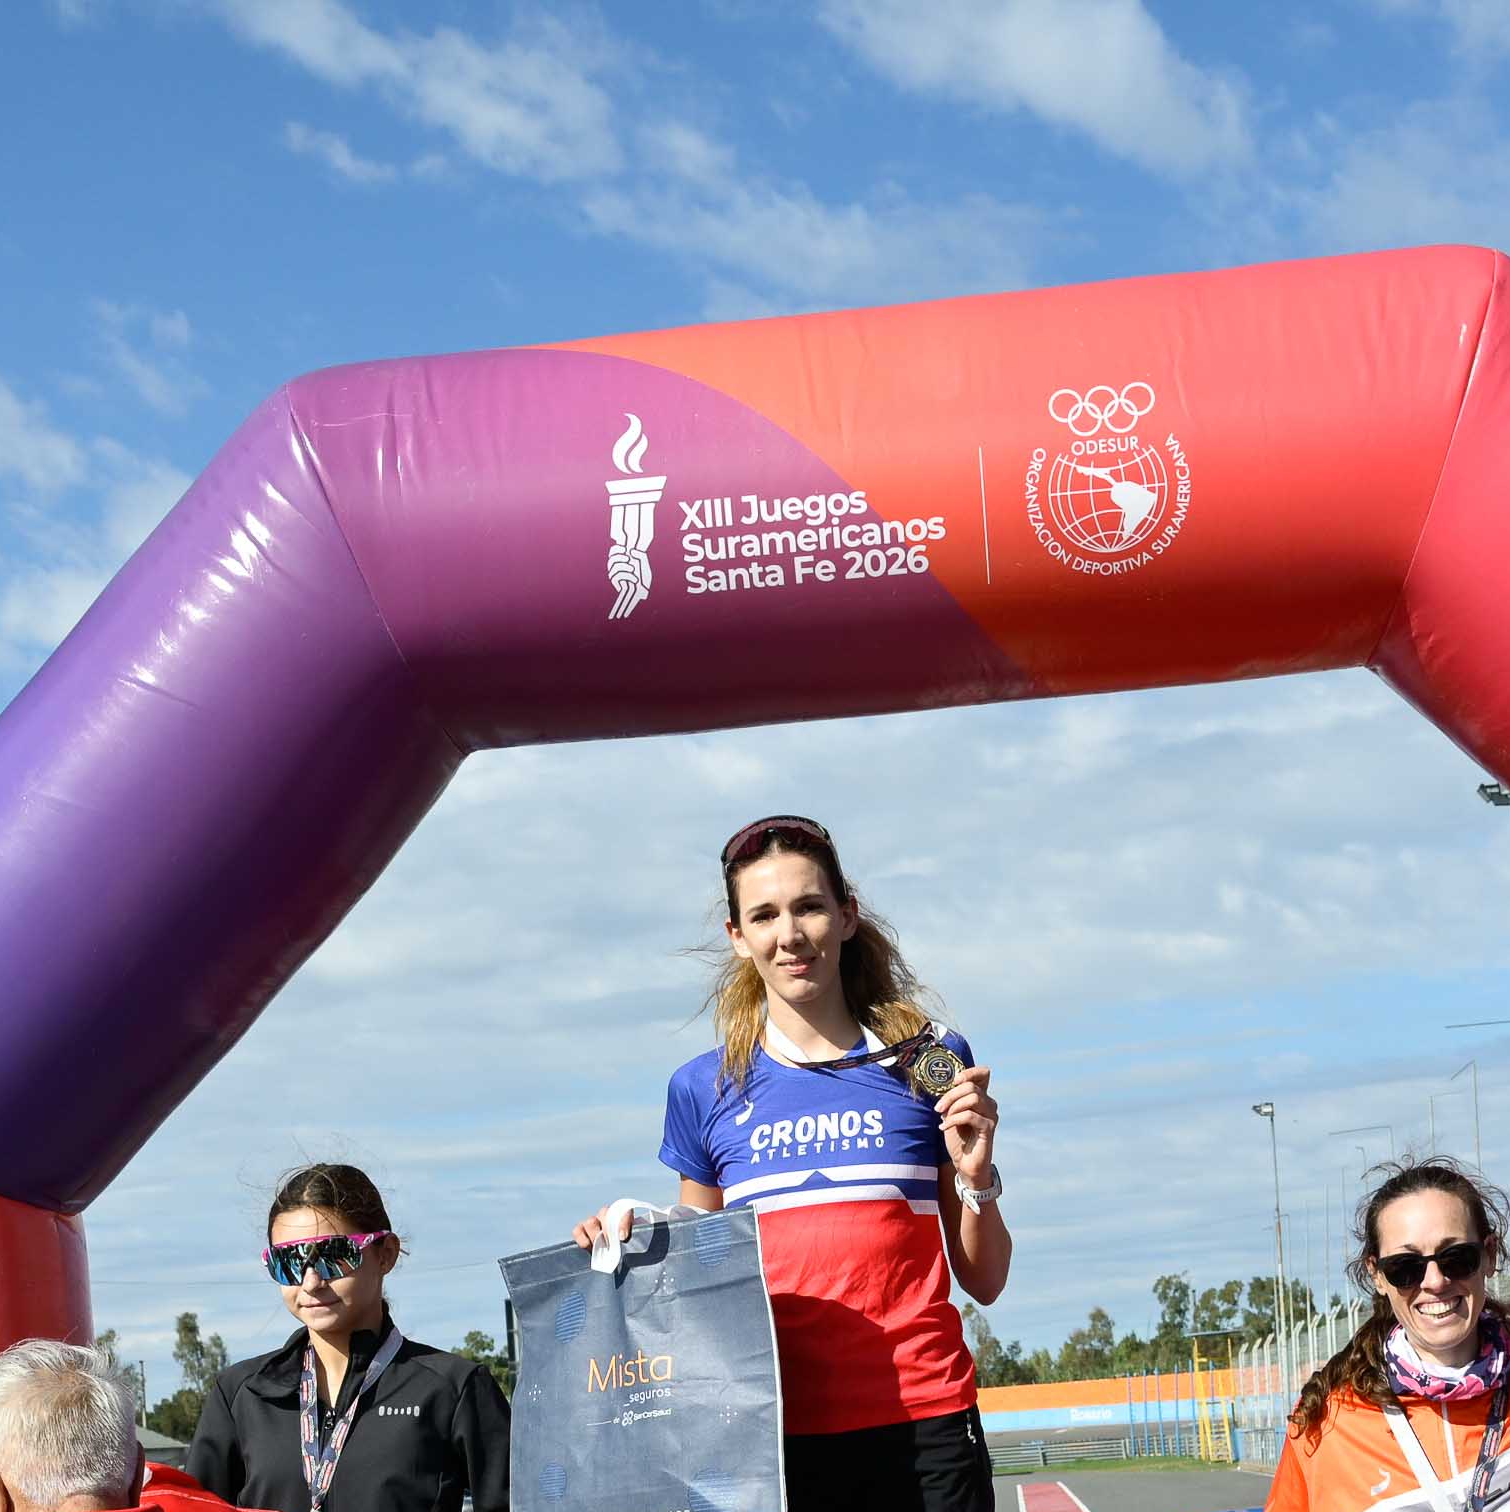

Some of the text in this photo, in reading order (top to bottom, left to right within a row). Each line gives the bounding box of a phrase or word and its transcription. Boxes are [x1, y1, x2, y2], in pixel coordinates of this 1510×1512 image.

[1071, 435, 1139, 456] ODESUR
[679, 491, 868, 531] XIII Juegos
[1025, 432, 1191, 576] ORGANIZACION DEPORTIVA SURAMERICANA
[682, 516, 947, 563] Suramericanos
[685, 545, 930, 594] Santa Fe 2026
[750, 1110, 884, 1151] CRONOS
[750, 1136, 885, 1165] ATLETISMO
[587, 1350, 673, 1393] Mista
